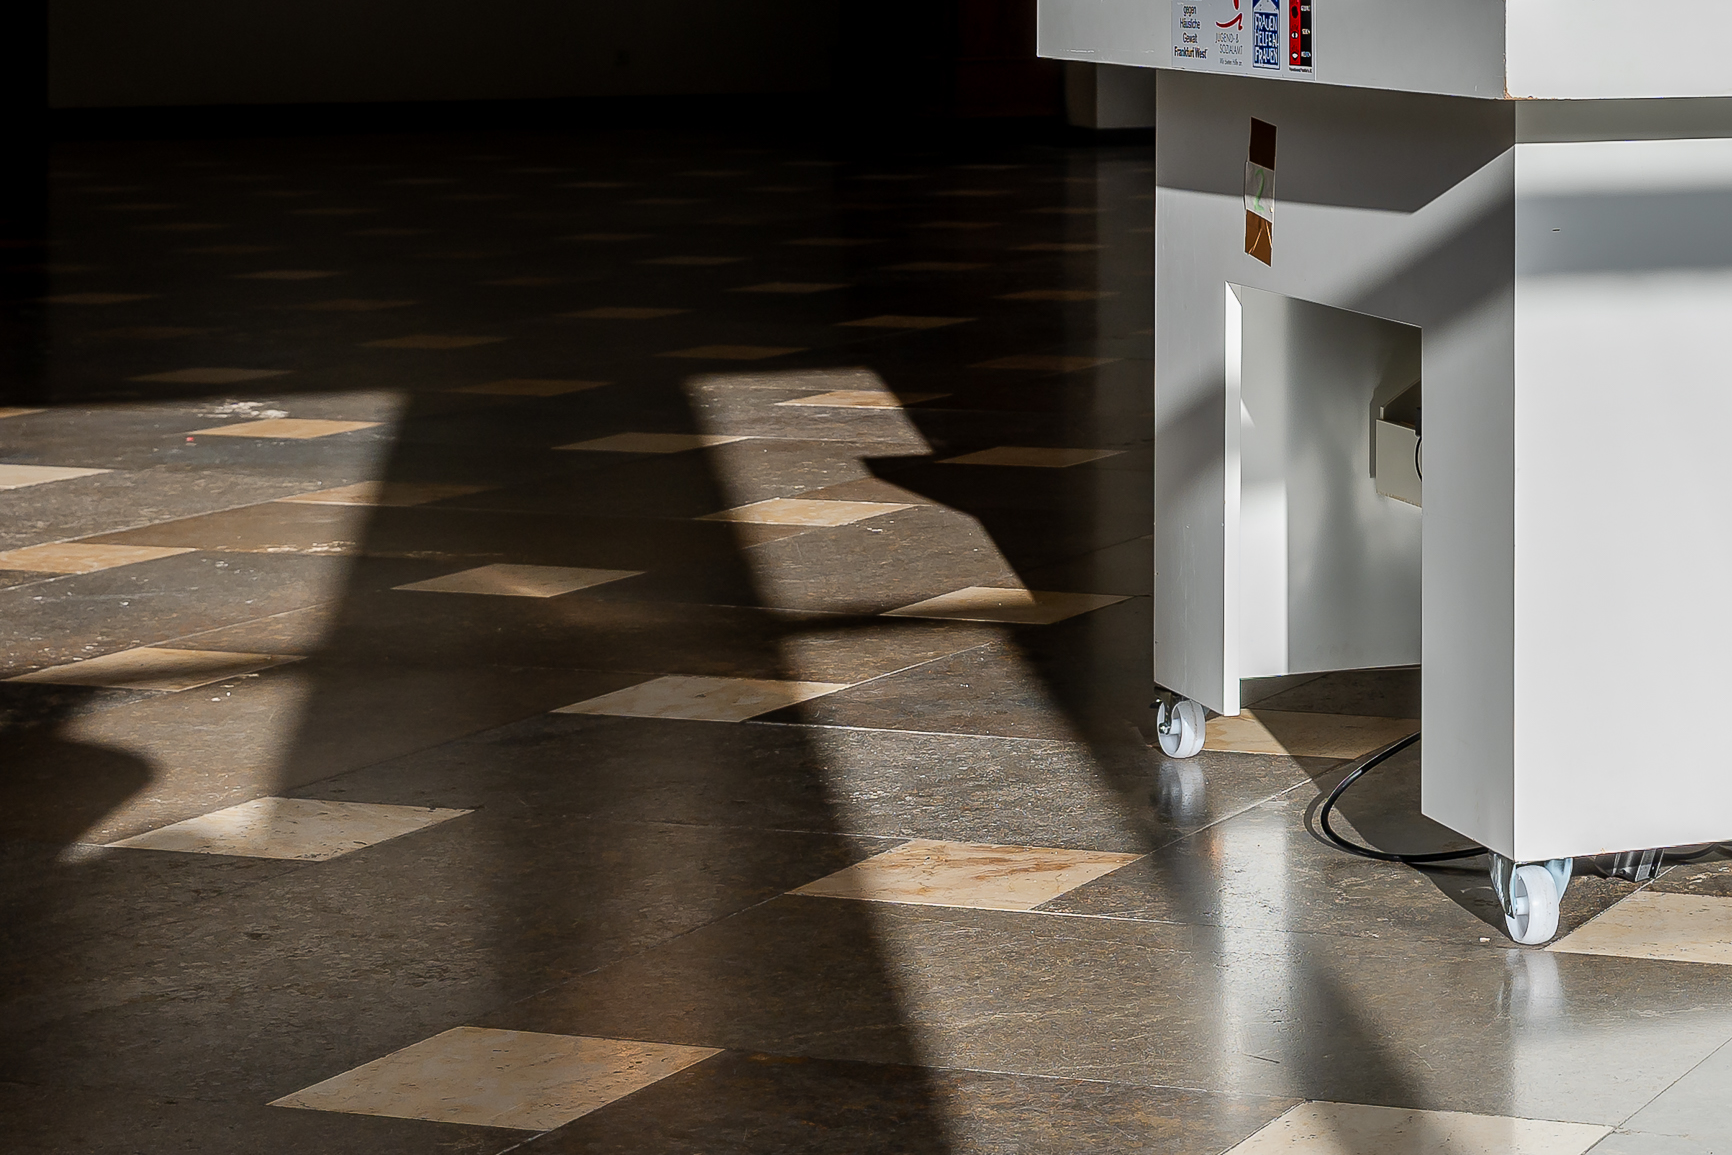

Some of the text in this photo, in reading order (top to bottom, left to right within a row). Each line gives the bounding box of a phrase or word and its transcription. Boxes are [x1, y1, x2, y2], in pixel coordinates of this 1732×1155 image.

[1183, 5, 1196, 16] gegen
[1254, 13, 1278, 31] FRAUEN
[1254, 47, 1278, 64] FRAUEN
